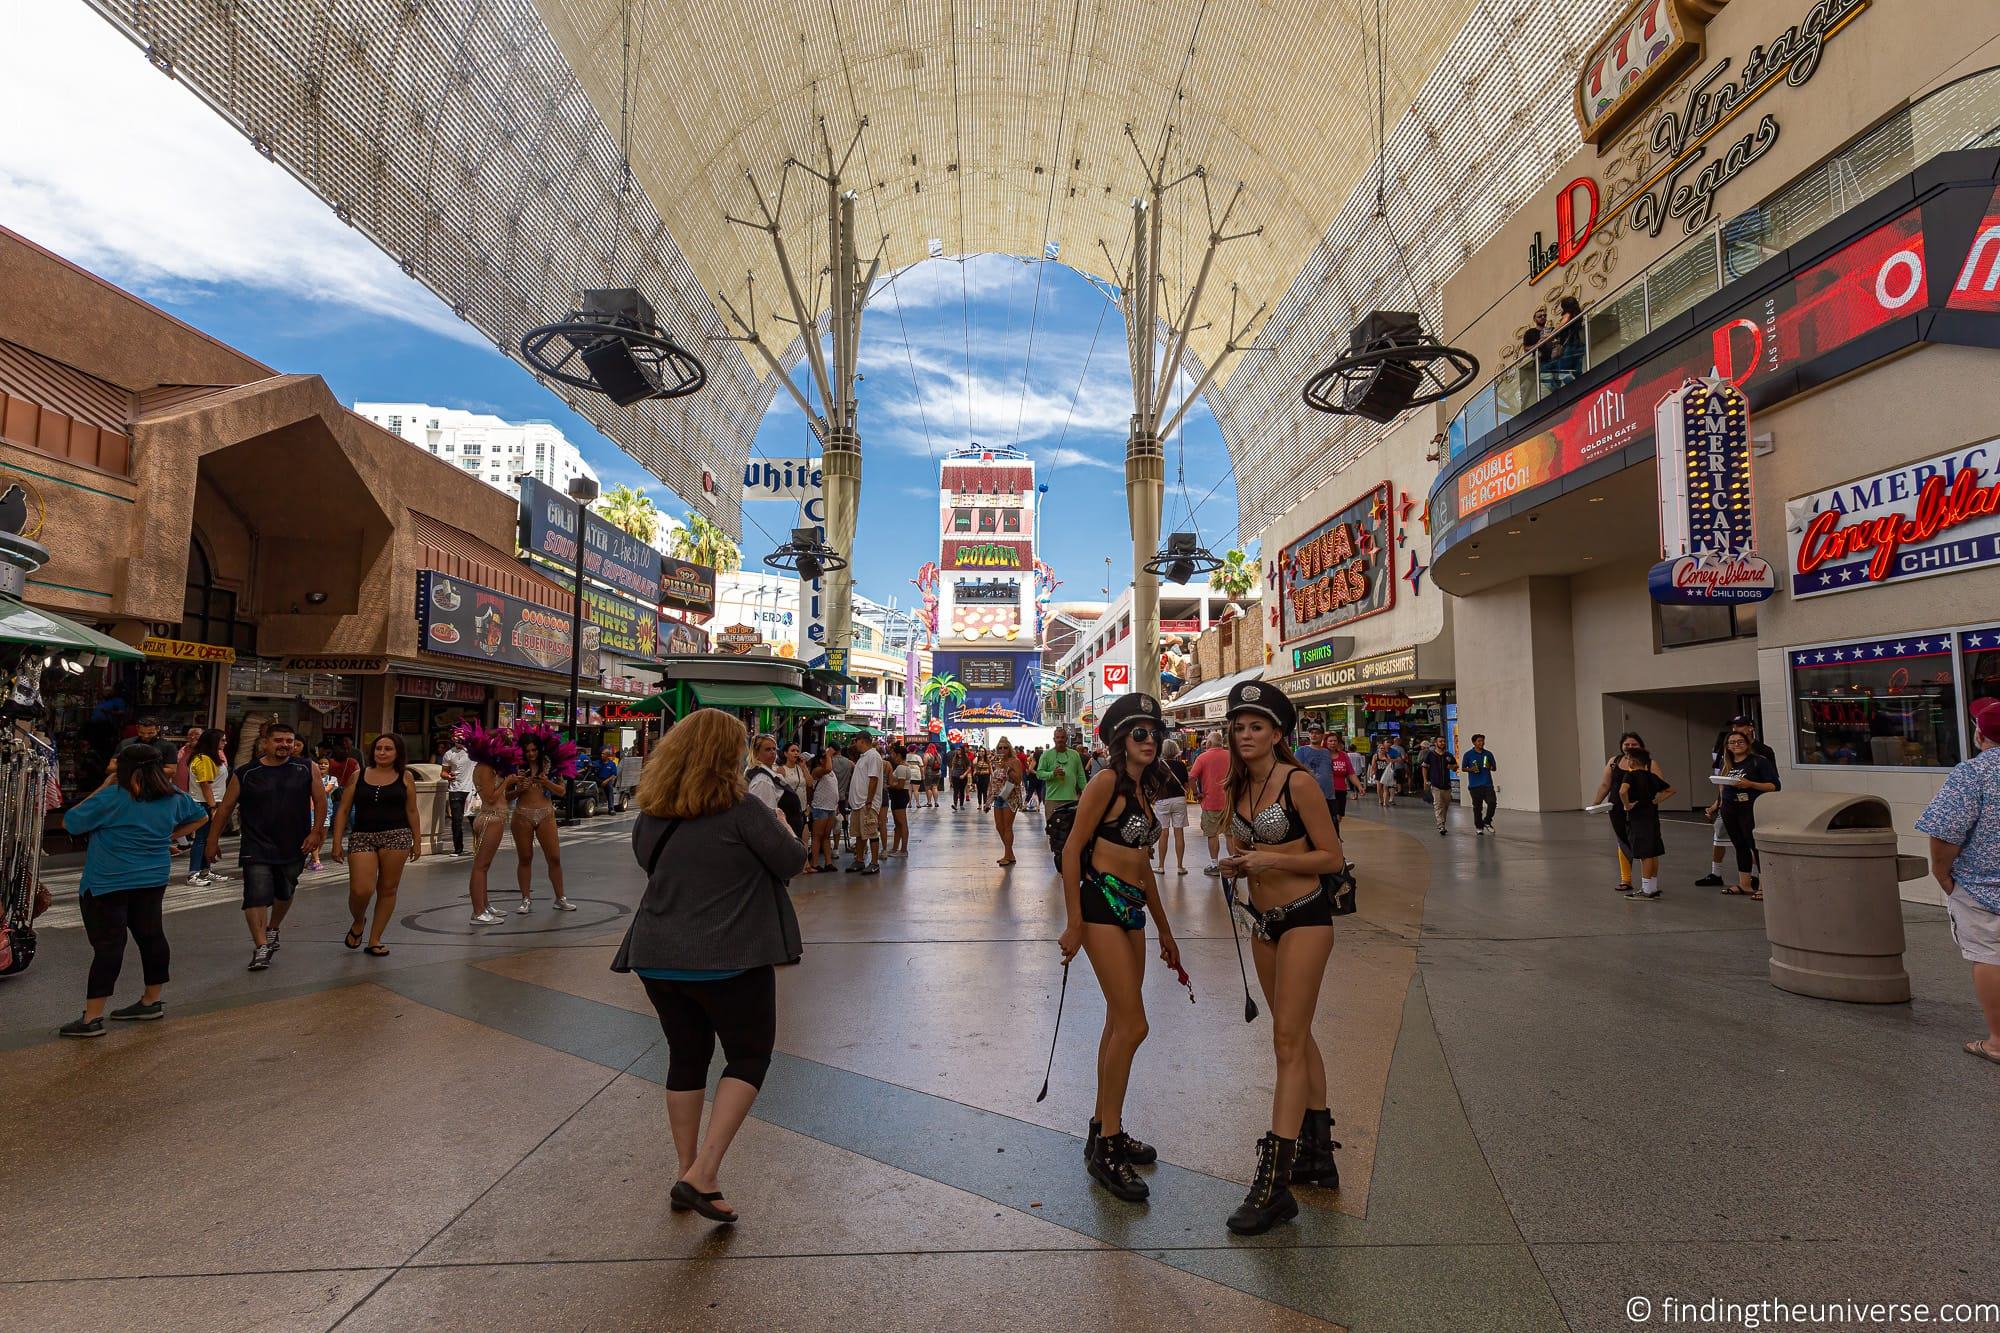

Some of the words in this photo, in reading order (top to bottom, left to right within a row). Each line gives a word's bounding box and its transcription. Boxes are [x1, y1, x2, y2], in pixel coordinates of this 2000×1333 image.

[1630, 113, 1780, 238] Vegas
[1528, 231, 1560, 279] the
[1555, 176, 1600, 267] D
[1766, 298, 1776, 342] VEGAS
[1768, 344, 1779, 372] LAS
[1580, 434, 1613, 455] GOLDEN
[1614, 421, 1638, 438] GATE
[1460, 489, 1478, 514] THE
[1479, 466, 1530, 504] ACTION!
[1467, 451, 1514, 490] DOUBLE
[1704, 396, 1731, 549] AMERICAN
[1829, 449, 2000, 517] AMERIC
[547, 499, 574, 534] COLD
[576, 514, 608, 552] ATER
[1797, 509, 1905, 582] Coney
[1901, 467, 2000, 544] Islan
[955, 544, 1021, 567] SLOTZILLA
[1296, 522, 1354, 580] VIVA
[1901, 541, 1978, 572] CHILI
[1291, 558, 1366, 624] VEGAS
[1677, 560, 1718, 598] Coney
[1718, 559, 1767, 586] Island
[1711, 588, 1735, 598] CHILI
[1736, 589, 1763, 598] DOGS
[511, 631, 522, 647] EL
[524, 634, 546, 652] BUEN
[548, 641, 573, 658] PASTO
[1302, 644, 1333, 664] T-SHIRTS
[286, 658, 382, 671] ACCESSORIES
[1291, 677, 1311, 692] HATS
[1315, 667, 1356, 688] LIQUOR
[1375, 655, 1414, 678] SWEATSHIRTS
[1369, 697, 1409, 708] LIQUOR
